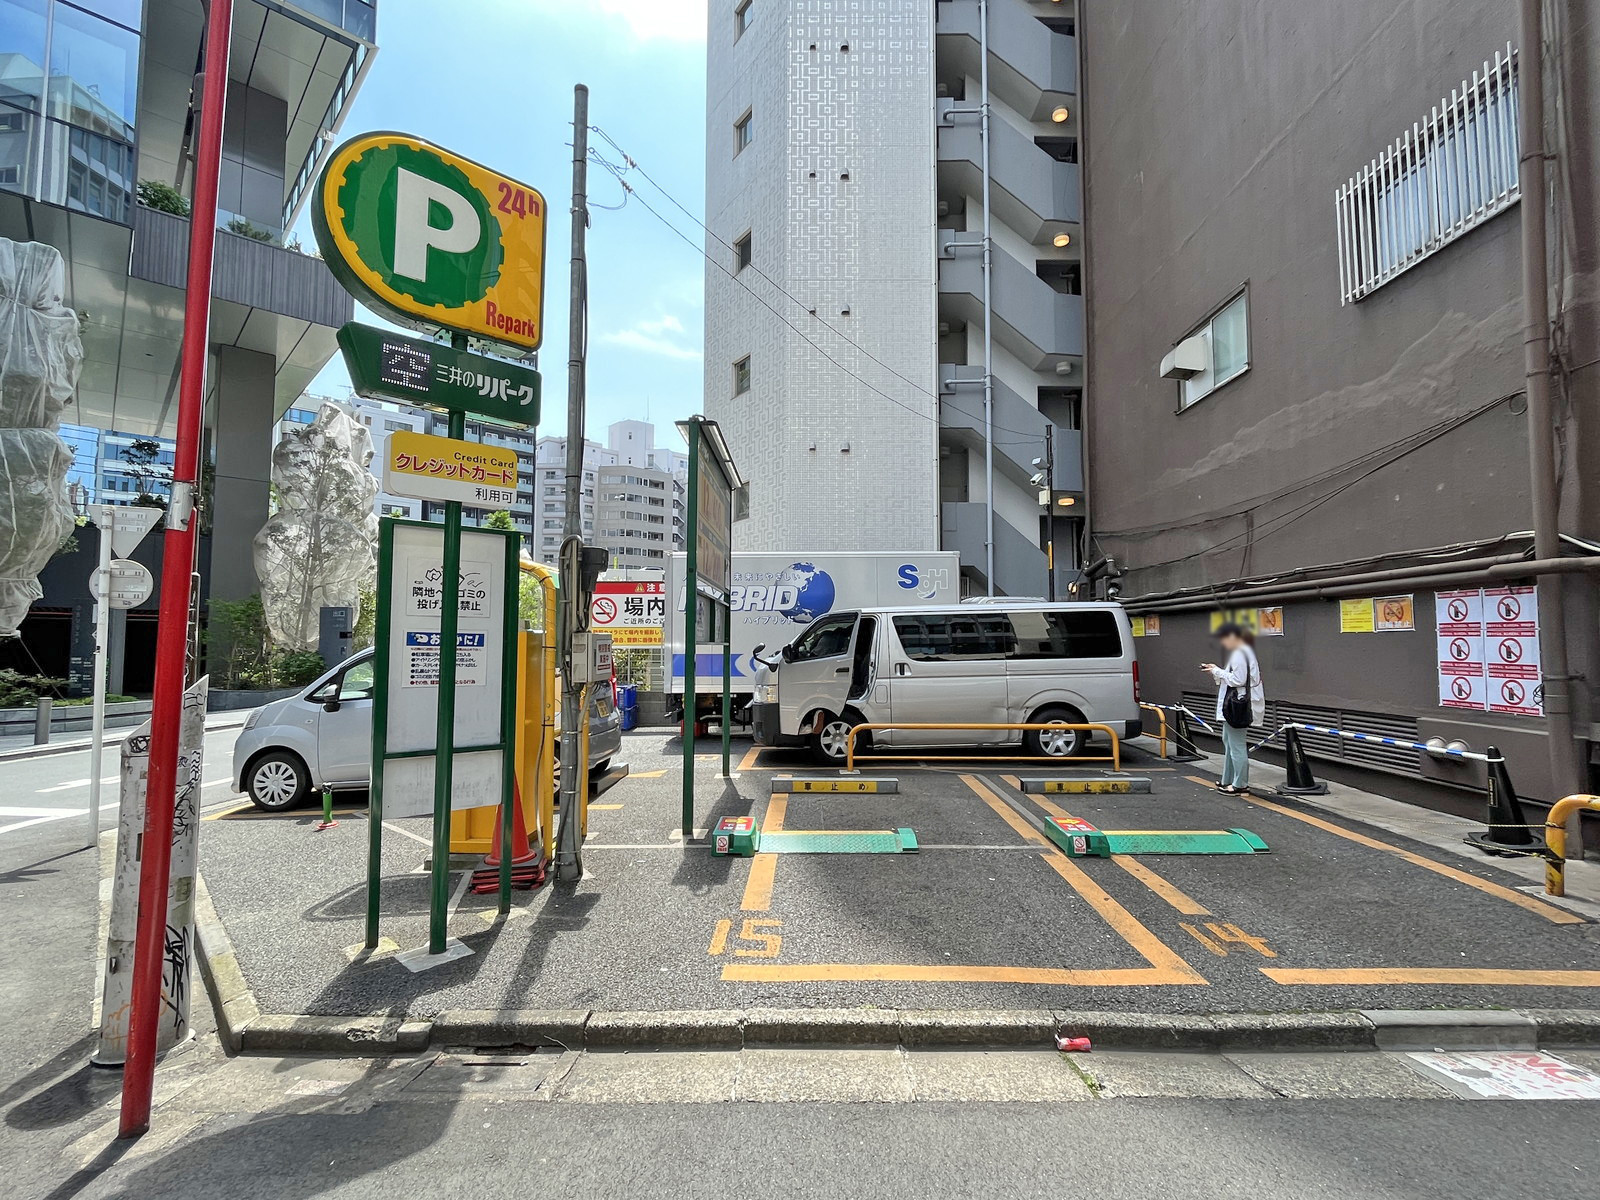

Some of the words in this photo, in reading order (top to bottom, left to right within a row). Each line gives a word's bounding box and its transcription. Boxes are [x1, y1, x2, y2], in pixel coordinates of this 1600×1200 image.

[497, 181, 540, 221] 24h
[393, 166, 482, 283] P
[485, 300, 536, 340] Repark
[435, 363, 534, 406] 三井のリパーク
[395, 453, 514, 485] クレジットカード
[454, 452, 487, 465] Credit
[490, 457, 514, 469] Card
[475, 487, 513, 504] 利用可
[412, 586, 486, 599] 隣地へゴミの
[417, 598, 481, 611] 投げ禁止
[624, 596, 665, 616] 場内
[707, 917, 784, 958] 15
